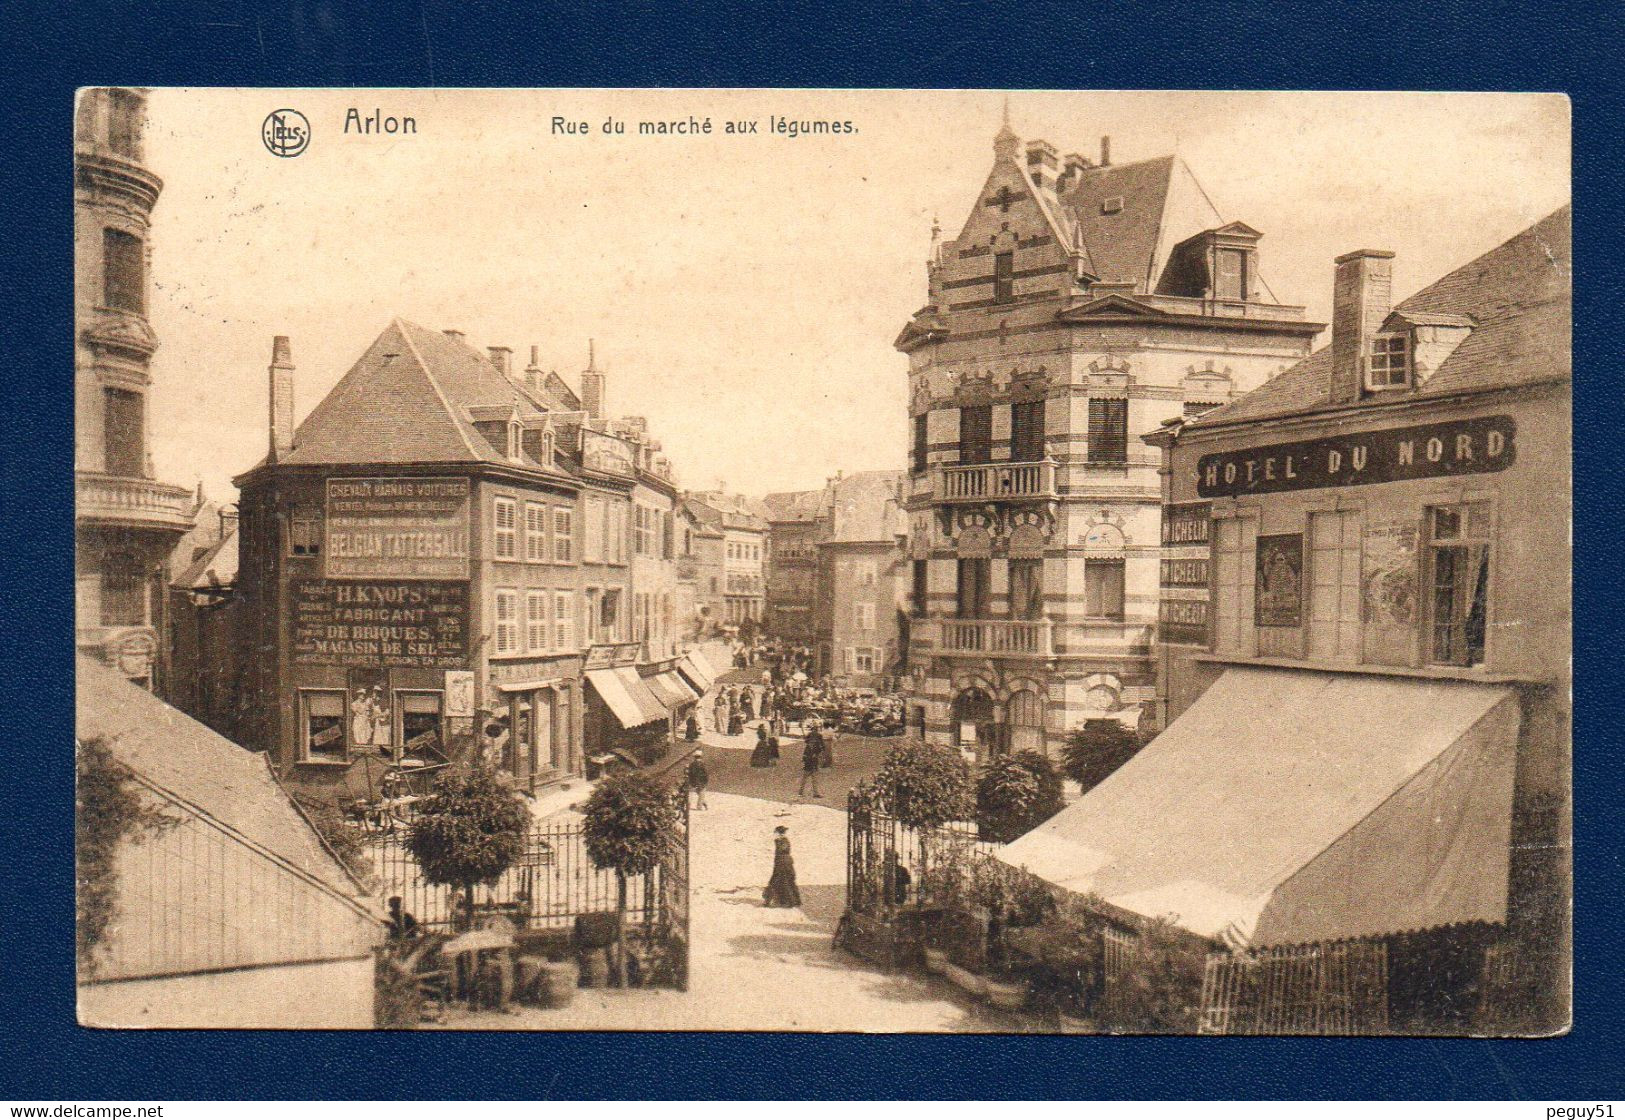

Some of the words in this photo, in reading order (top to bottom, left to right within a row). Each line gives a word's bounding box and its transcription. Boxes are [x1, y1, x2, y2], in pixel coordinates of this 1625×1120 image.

[1205, 456, 1297, 487] HOTEL
[1328, 446, 1367, 474] DU
[1399, 430, 1505, 465] NORD
[1163, 520, 1208, 542] MICHELIN
[334, 608, 425, 621] FABRICANT
[327, 626, 348, 639] DE
[314, 640, 379, 654] MAGASIN
[382, 642, 402, 654] DE
[408, 642, 437, 655] SEL
